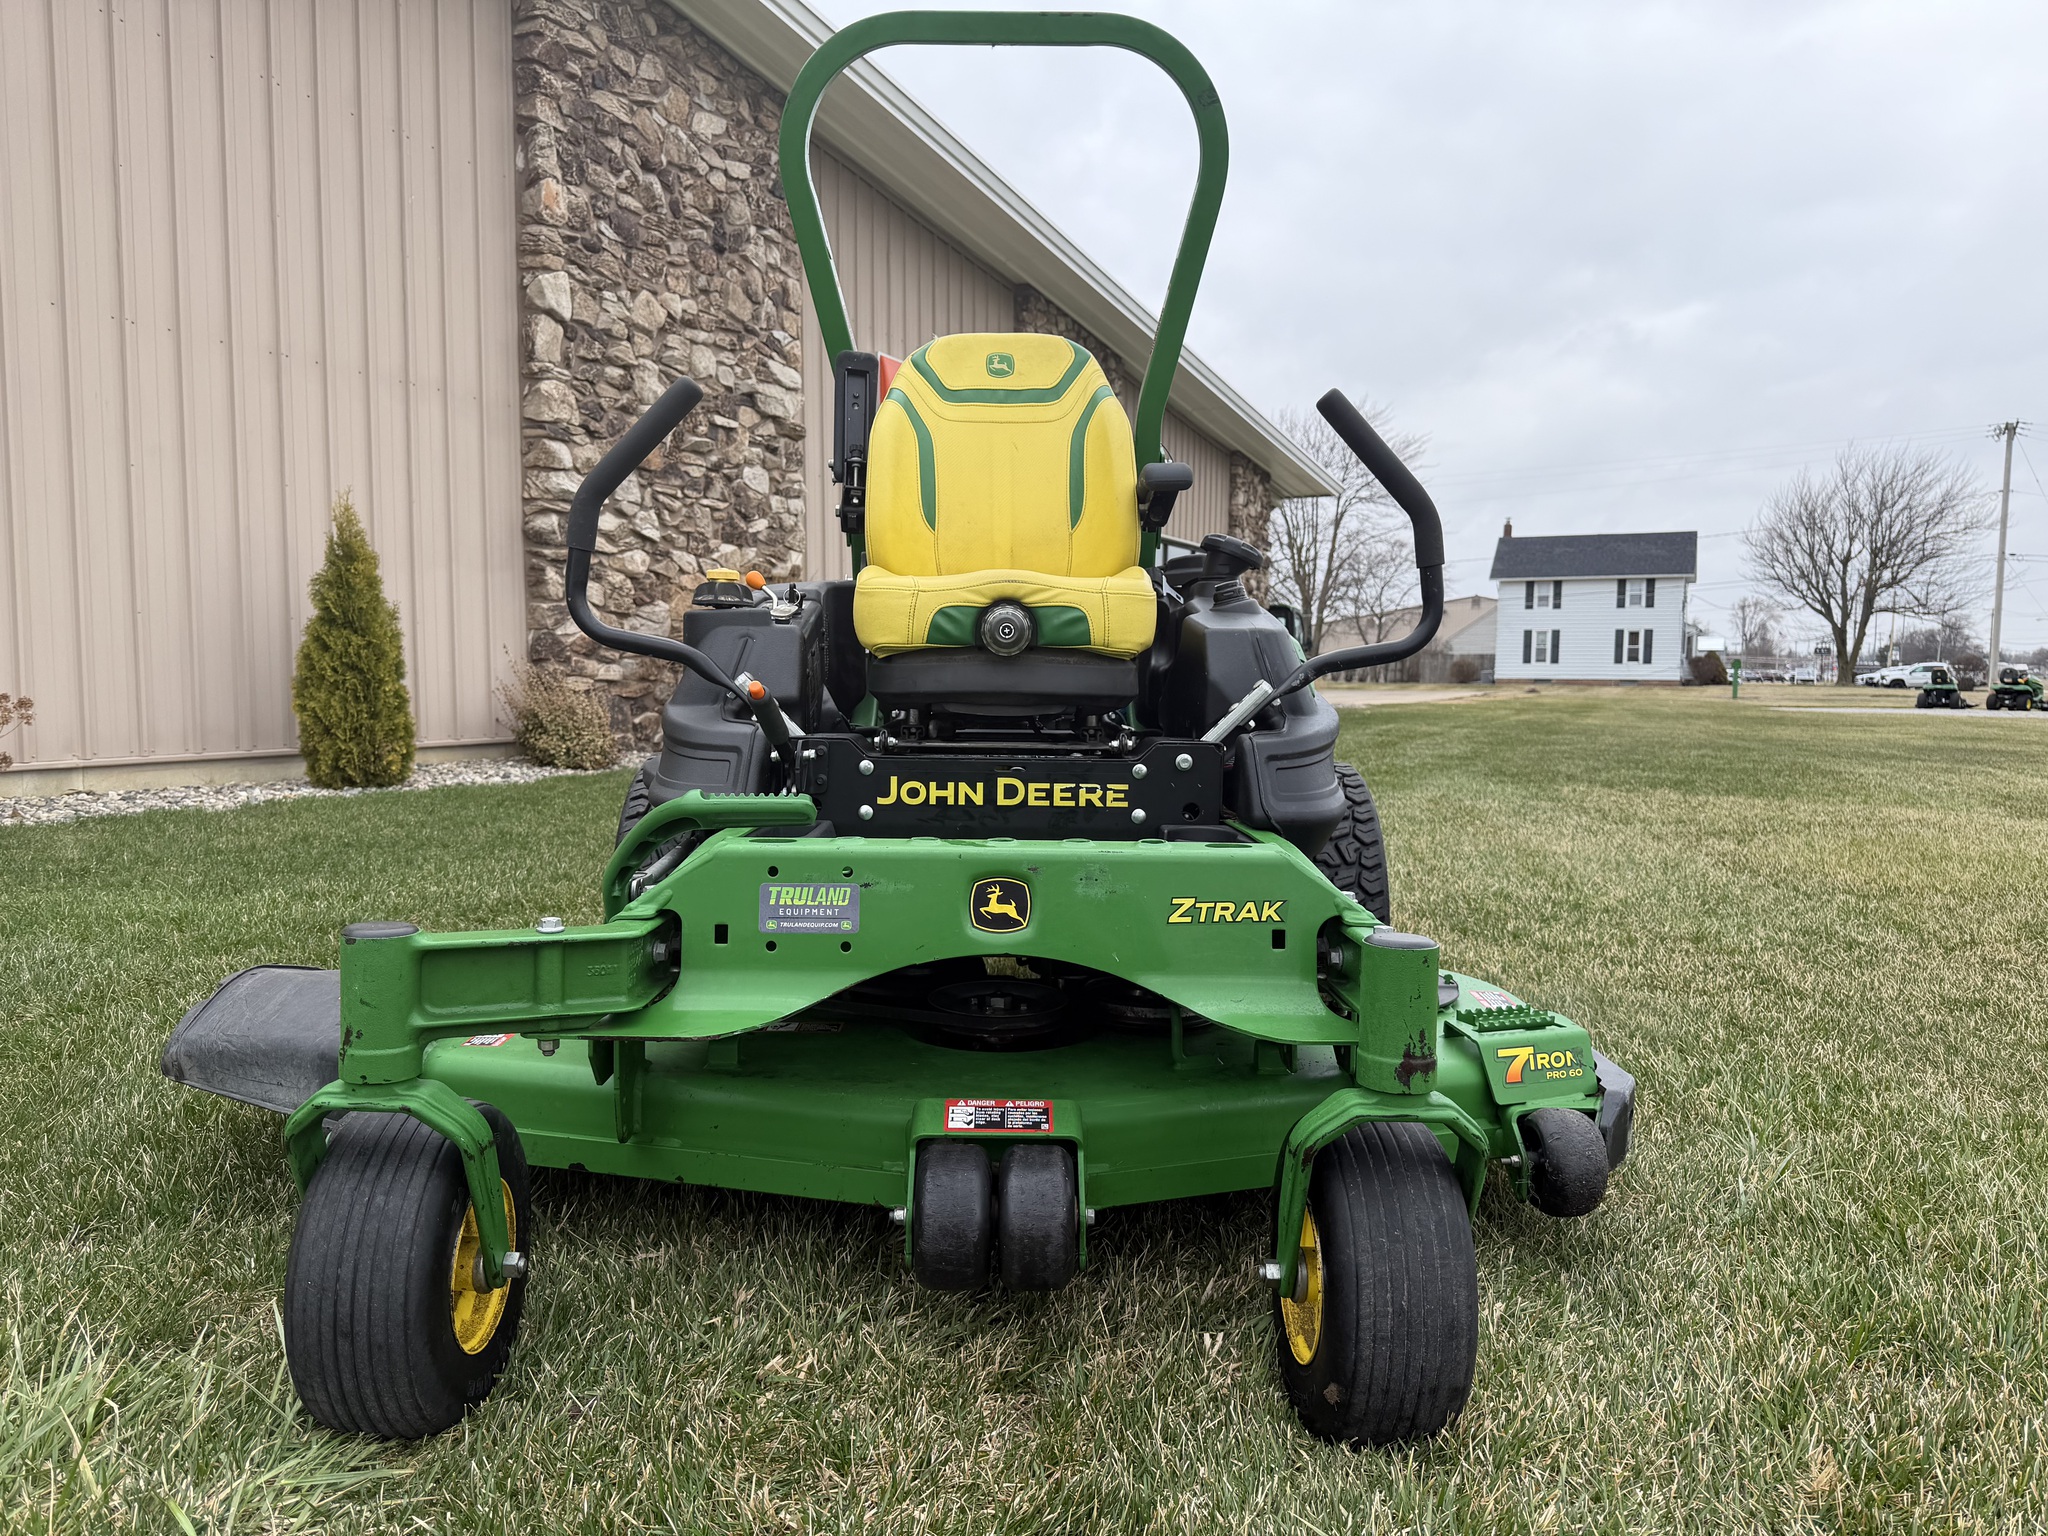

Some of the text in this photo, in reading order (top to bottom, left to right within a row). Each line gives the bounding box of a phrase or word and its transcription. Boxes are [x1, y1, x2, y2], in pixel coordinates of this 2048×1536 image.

[877, 776, 1129, 808] JOHN DEERE
[768, 887, 851, 906] TRULAND
[779, 908, 840, 916] EQUIPMENT
[1167, 897, 1287, 924] ZTRAK
[1546, 1068, 1583, 1080] PRO 60
